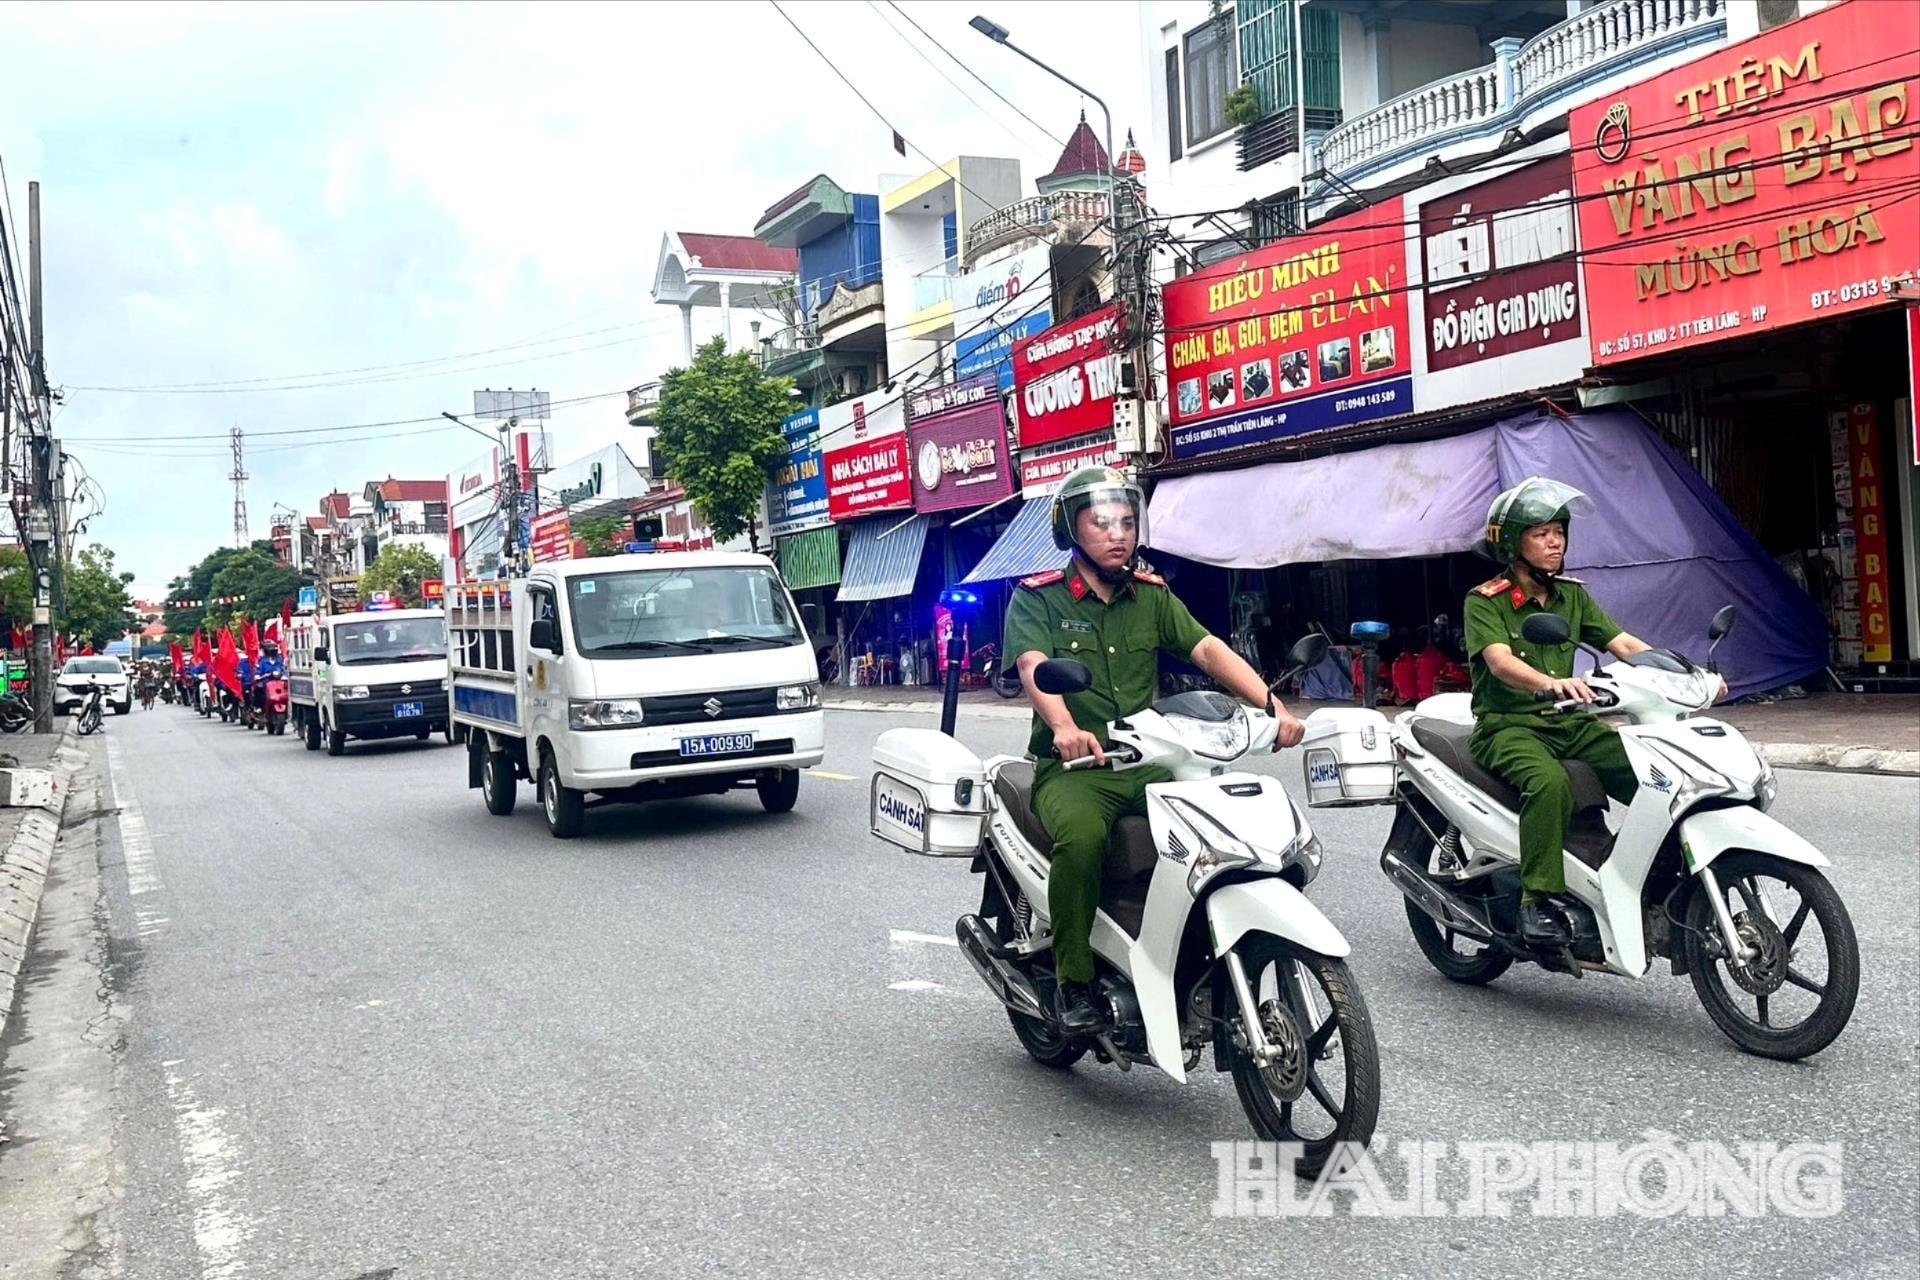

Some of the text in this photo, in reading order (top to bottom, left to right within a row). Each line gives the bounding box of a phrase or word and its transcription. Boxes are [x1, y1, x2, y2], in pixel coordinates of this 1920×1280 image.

[1675, 41, 1824, 126] TIỆM
[1602, 83, 1913, 236] VÀNG BẠC
[1005, 276, 1020, 302] 10
[1208, 241, 1342, 313] HIẾU MINH
[1840, 279, 1878, 302] 0313
[1213, 326, 1236, 357] GA,
[1269, 303, 1304, 344] ĐỆM
[1433, 281, 1577, 354] ĐỒ ĐIỆN GIA DỤNG
[1648, 327, 1667, 345] KHU
[1669, 326, 1677, 340] 2
[1752, 305, 1768, 322] HP
[831, 458, 851, 482] NHÀ
[851, 453, 873, 477] SÁCH
[1642, 780, 1671, 794] HONDA
[880, 789, 908, 824] CẢNH
[1160, 849, 1188, 866] HONDA
